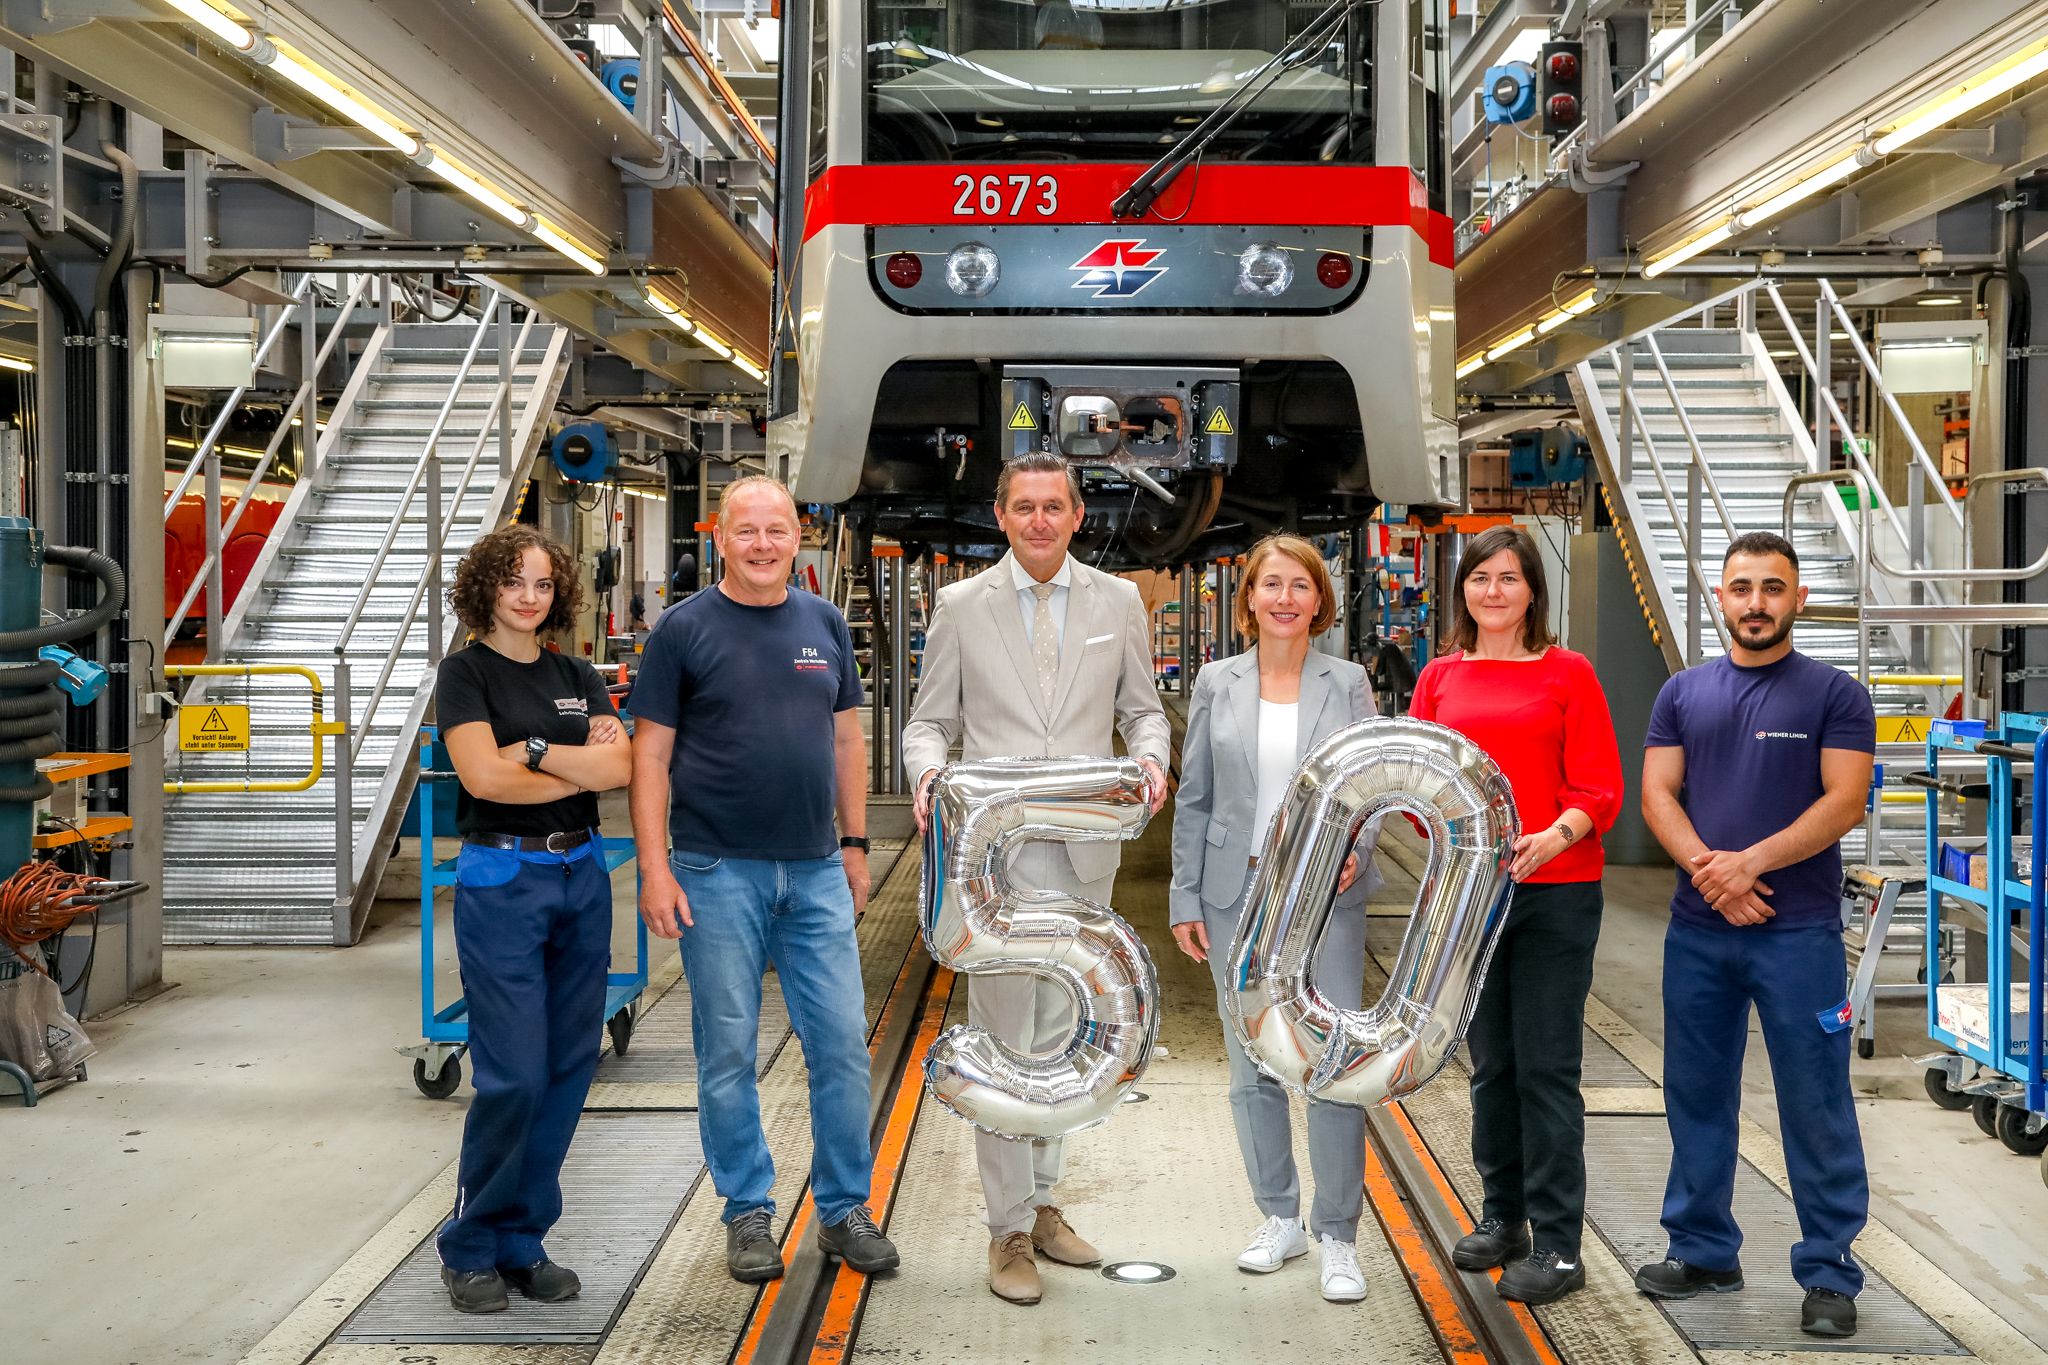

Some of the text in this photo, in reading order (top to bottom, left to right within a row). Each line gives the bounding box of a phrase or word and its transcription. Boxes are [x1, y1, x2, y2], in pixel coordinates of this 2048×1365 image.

[953, 174, 1058, 216] 2673
[801, 647, 818, 657] F54
[218, 734, 237, 742] Anlage
[218, 741, 244, 749] Spannung
